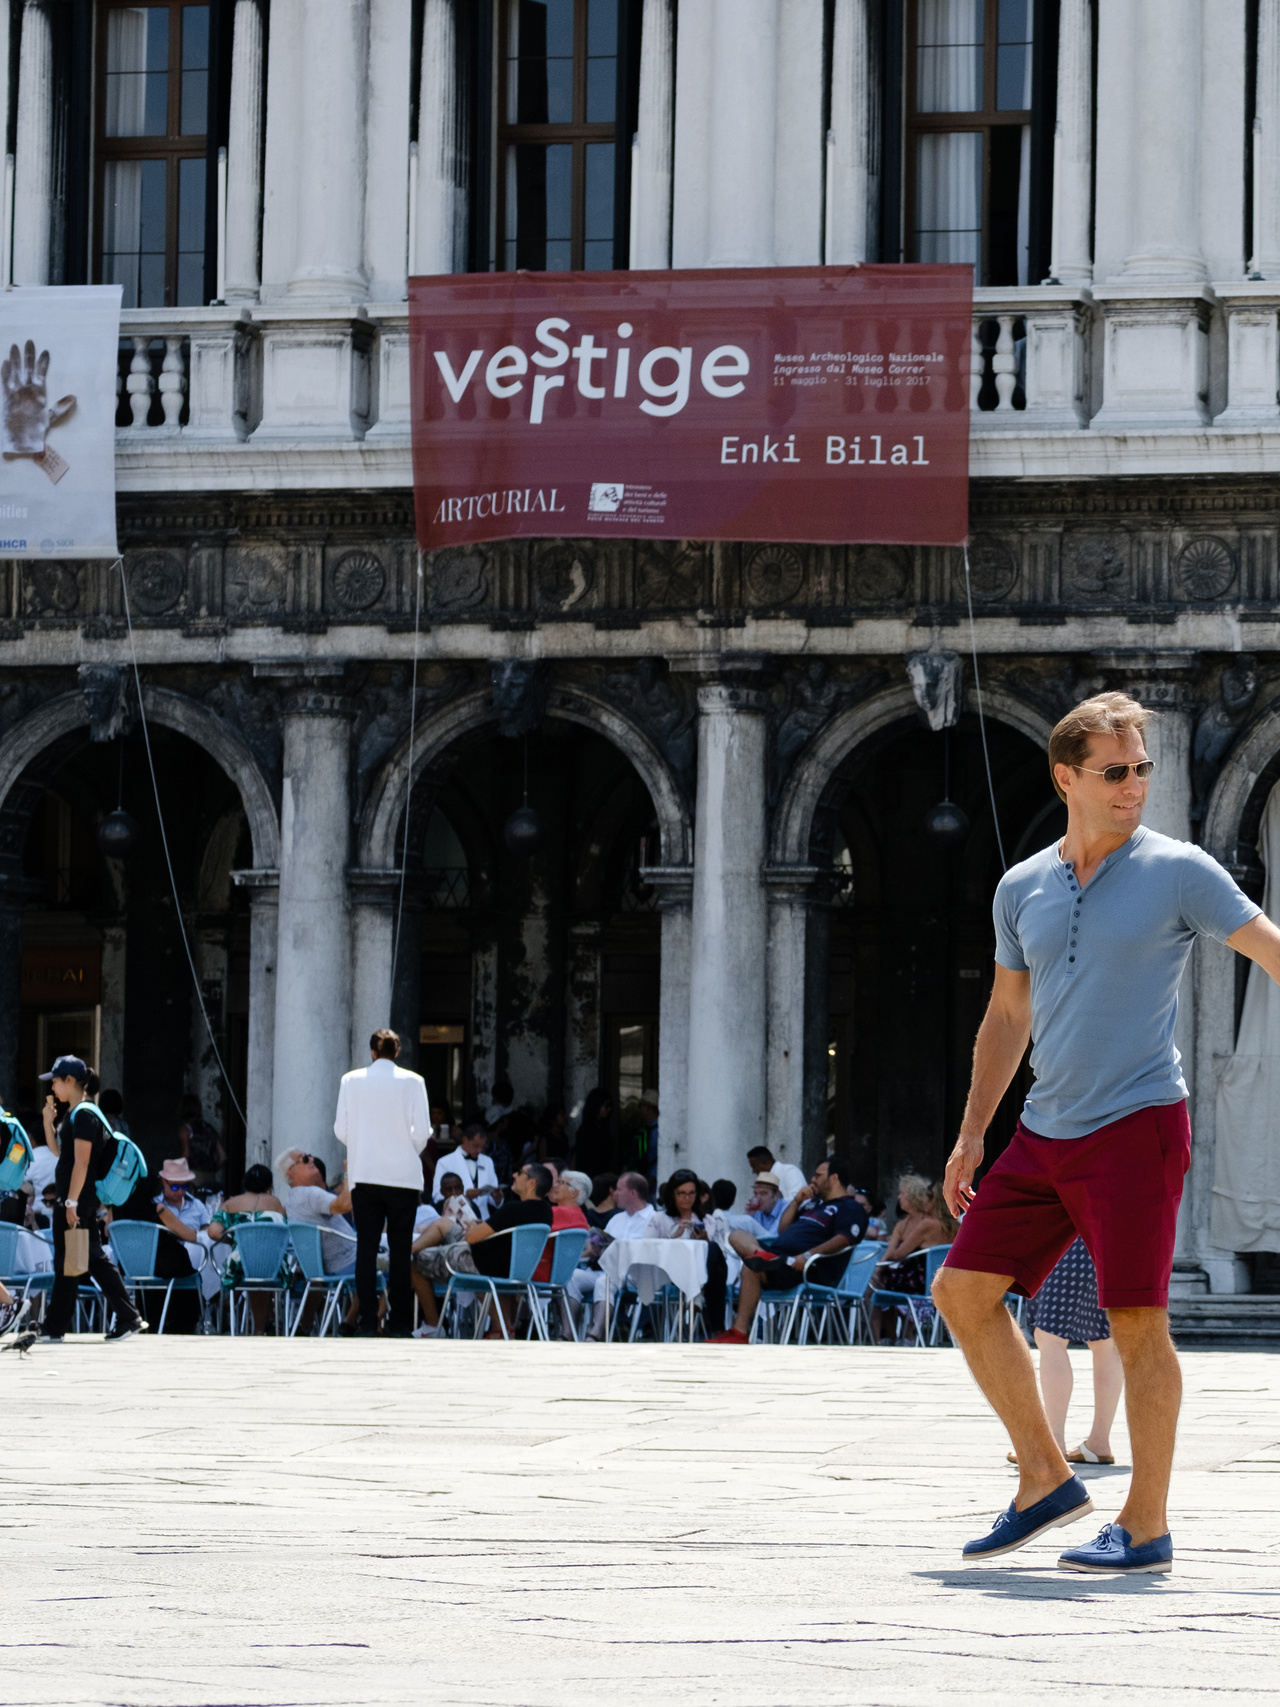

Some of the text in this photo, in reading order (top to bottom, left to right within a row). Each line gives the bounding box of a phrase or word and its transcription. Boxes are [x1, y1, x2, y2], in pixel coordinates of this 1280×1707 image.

[774, 351, 944, 363] Museo Archeologico Nazionale
[773, 363, 925, 375] ingresso dal Museo Correr
[773, 377, 785, 386] 11
[791, 376, 827, 387] maggio
[845, 376, 857, 386] 31
[864, 376, 900, 387] luglio
[905, 376, 931, 386] 2017
[721, 434, 930, 465] Enki Bilal
[433, 488, 566, 524] ARTCURIAL
